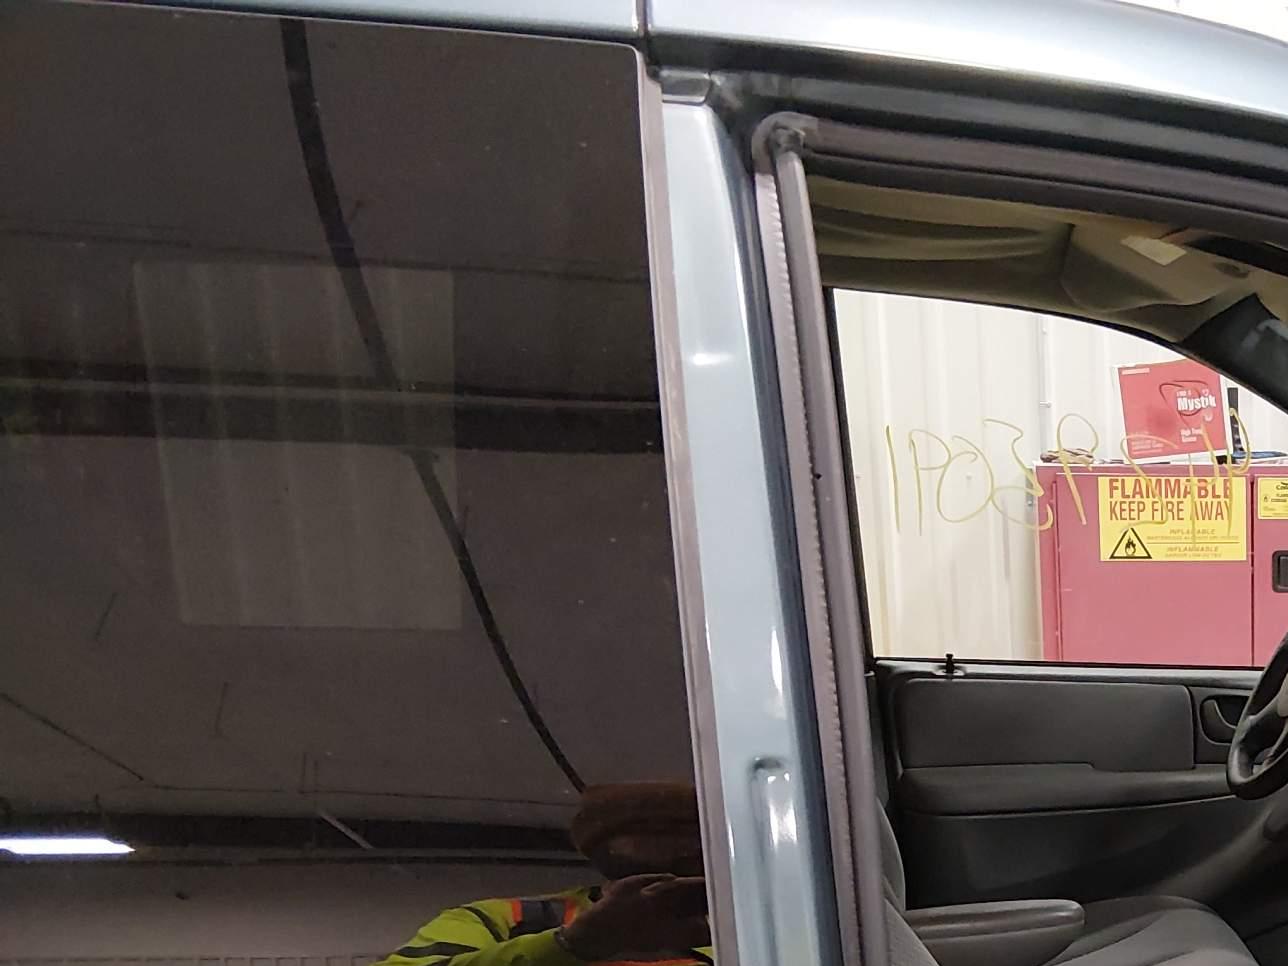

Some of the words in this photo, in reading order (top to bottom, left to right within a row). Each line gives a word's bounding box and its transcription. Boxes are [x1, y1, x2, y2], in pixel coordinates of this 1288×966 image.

[1177, 393, 1216, 412] Mystik
[1109, 478, 1233, 499] FLAMMABLE
[1109, 500, 1146, 521] KEEP
[1151, 500, 1185, 521] FIRE
